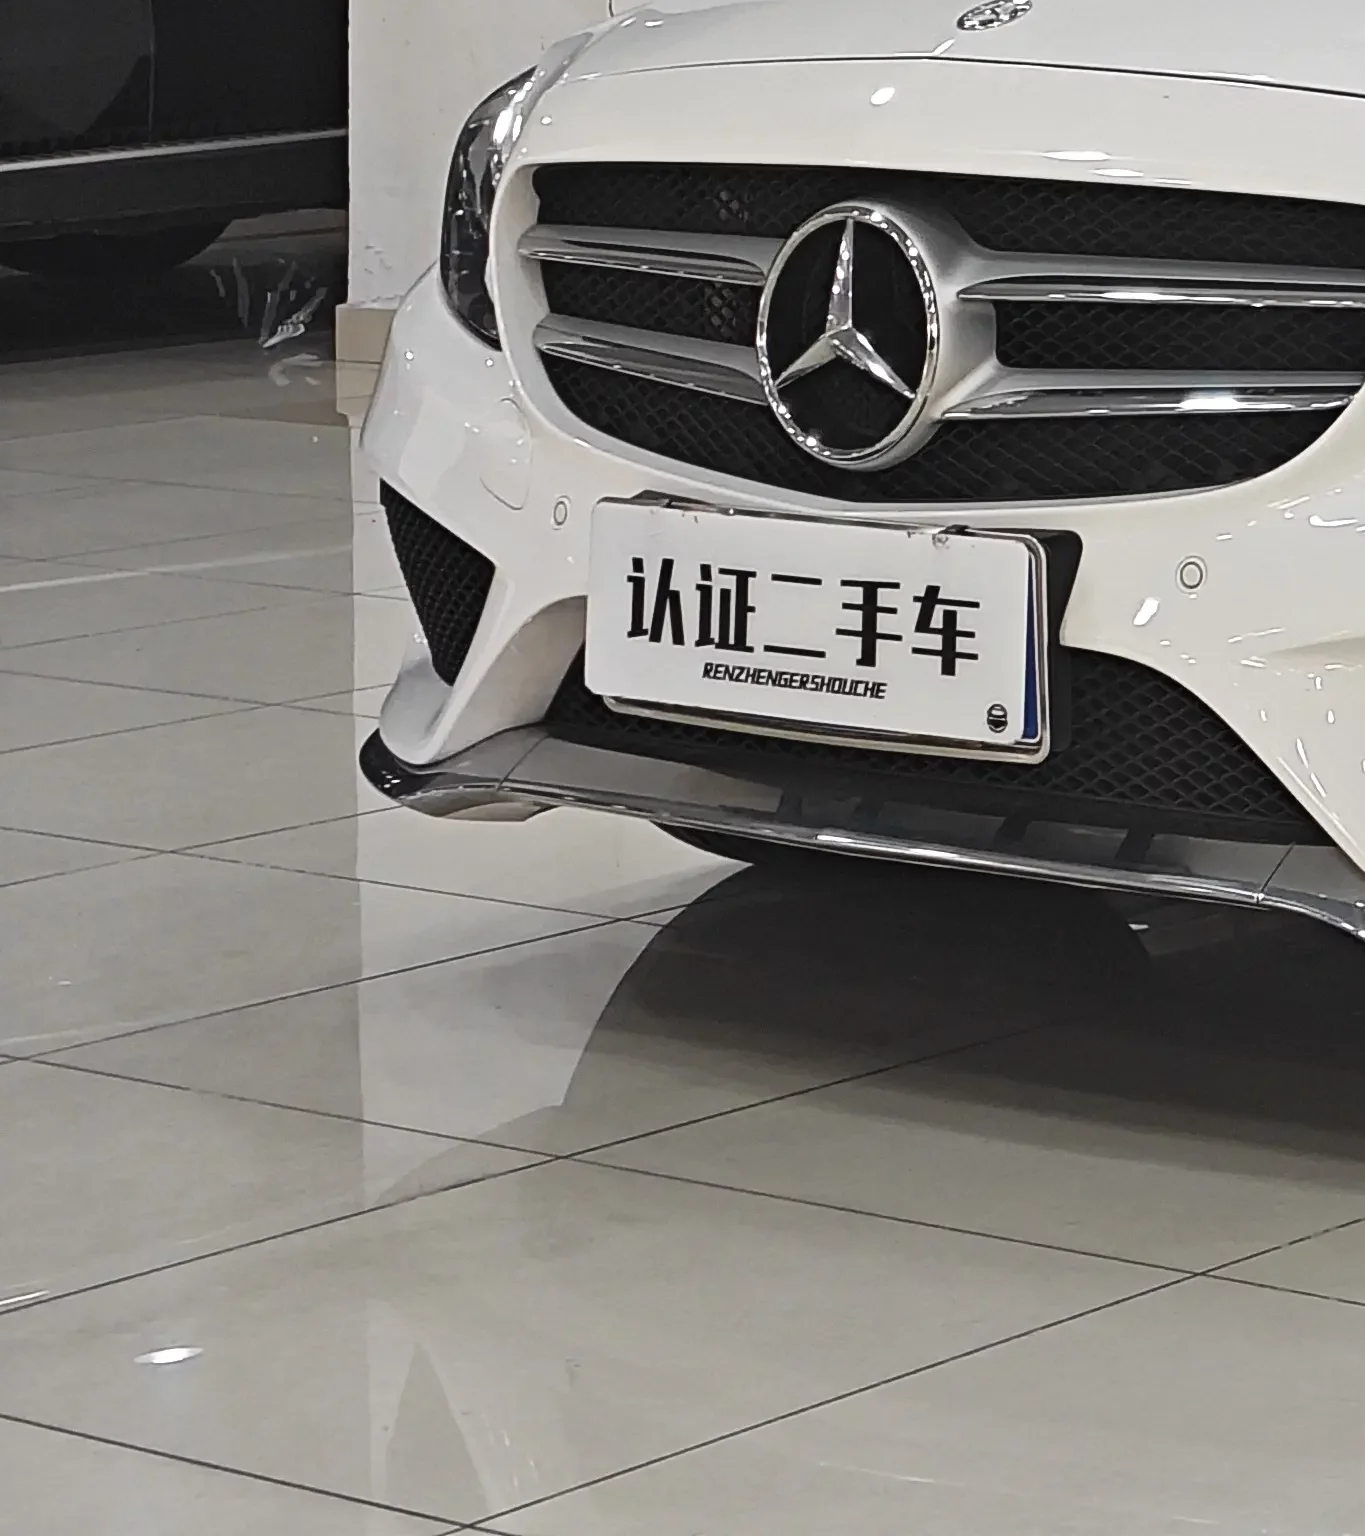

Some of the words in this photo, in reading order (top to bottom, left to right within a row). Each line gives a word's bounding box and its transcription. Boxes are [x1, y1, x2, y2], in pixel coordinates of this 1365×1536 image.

[626, 557, 981, 677] 认证二手车
[702, 661, 887, 700] RENZHENGERSHOUCHE
